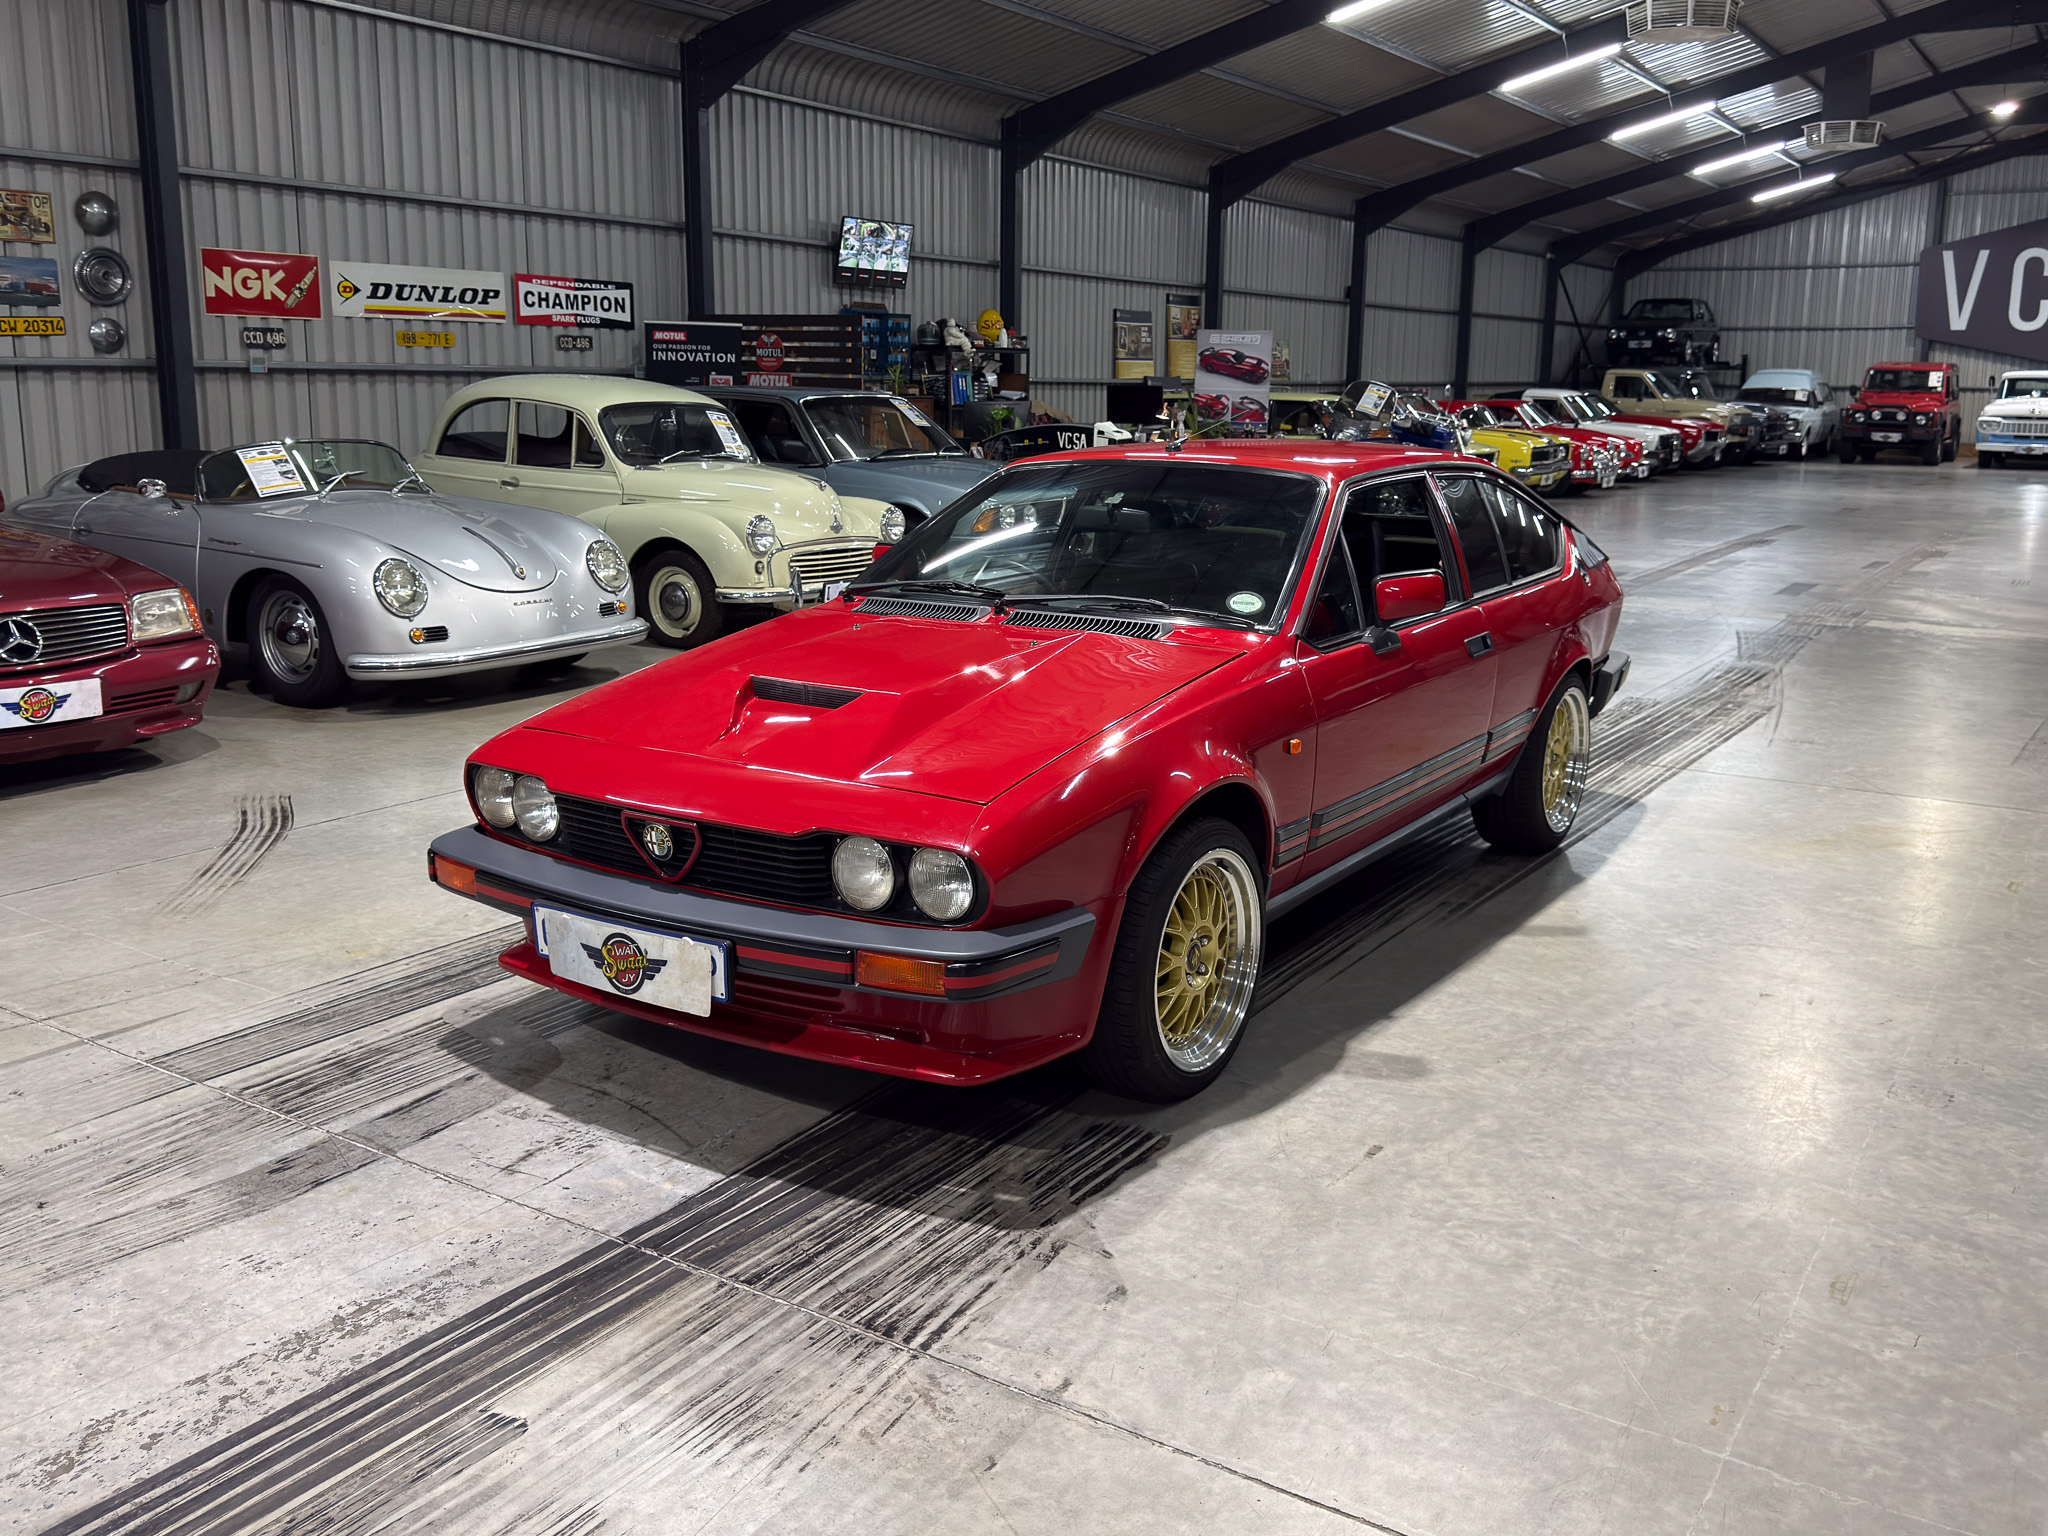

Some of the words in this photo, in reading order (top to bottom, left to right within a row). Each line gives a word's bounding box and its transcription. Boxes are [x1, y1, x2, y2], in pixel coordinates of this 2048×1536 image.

[21, 194, 49, 208] STOP
[204, 266, 287, 301] NGK
[532, 279, 616, 290] DEPENDABLE
[366, 282, 501, 305] DUNLOP
[523, 290, 626, 313] CHAMPION
[22, 319, 63, 333] 20314
[552, 315, 576, 323] SPARK
[577, 316, 600, 324] PLUGS
[243, 331, 263, 344] CCD
[654, 332, 686, 340] MOTUL
[652, 351, 736, 363] INNOVATION
[756, 348, 782, 357] MOTUL
[749, 374, 790, 387] MOTUL
[1056, 431, 1087, 450] VCSA
[601, 945, 649, 979] Swaai
[622, 973, 636, 982] JY
